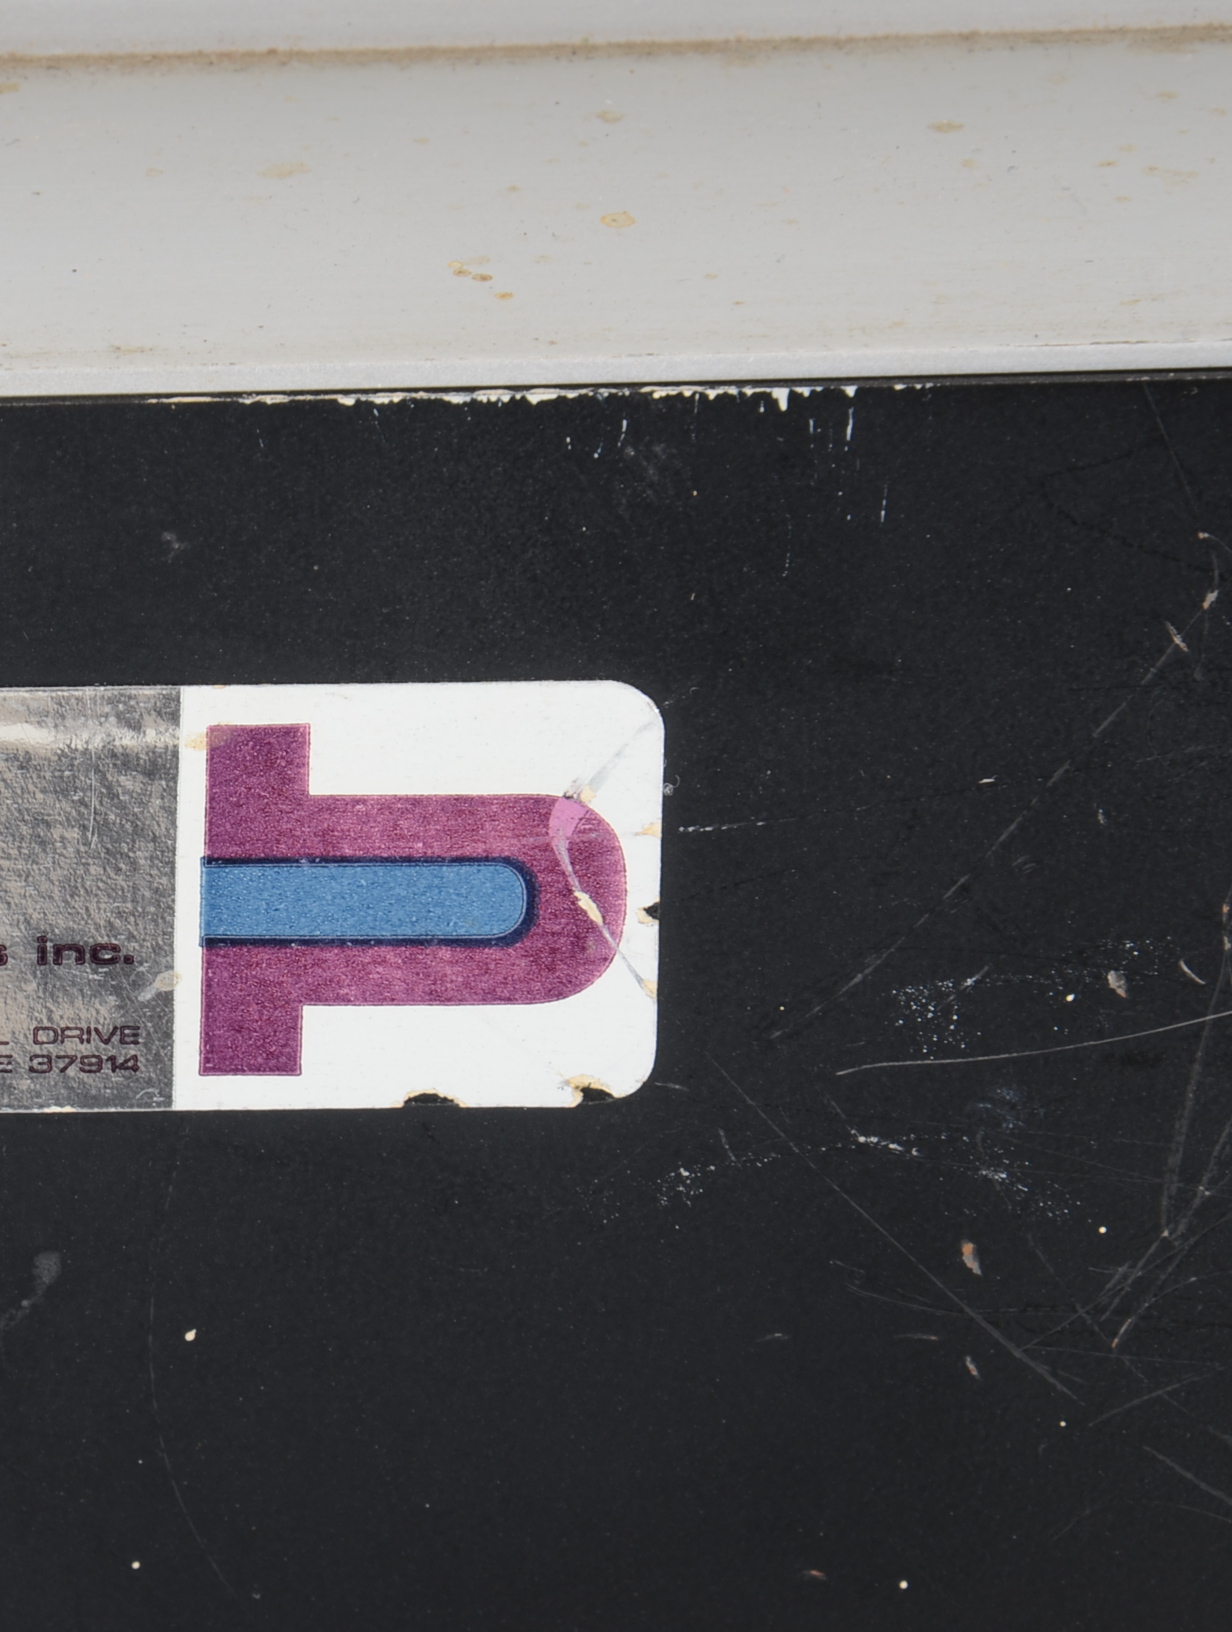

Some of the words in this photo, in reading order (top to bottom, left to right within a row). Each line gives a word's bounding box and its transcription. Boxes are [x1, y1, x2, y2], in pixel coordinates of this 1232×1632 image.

[35, 935, 135, 966] inc.
[32, 1025, 141, 1045] DRIVE
[28, 1053, 141, 1073] 37914
